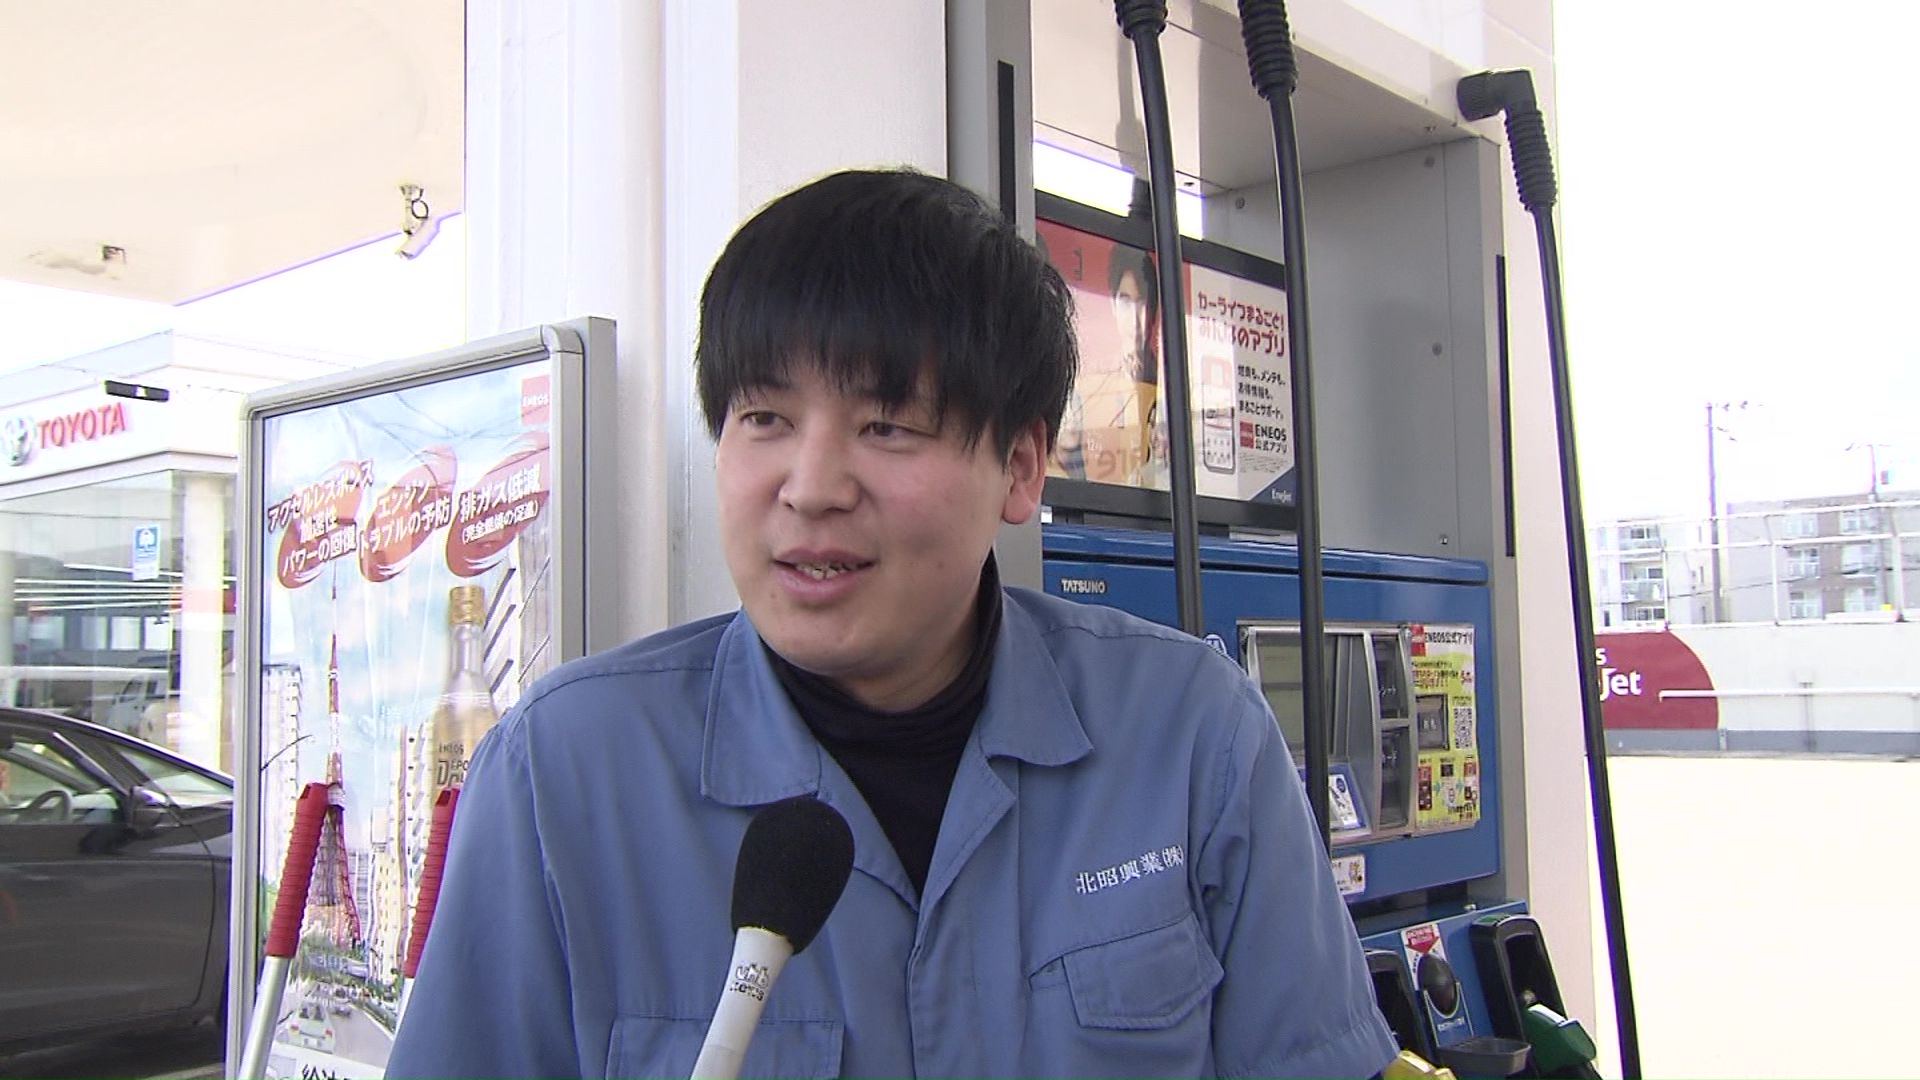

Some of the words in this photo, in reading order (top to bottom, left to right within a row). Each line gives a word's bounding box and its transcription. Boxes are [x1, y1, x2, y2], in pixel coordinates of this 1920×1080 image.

[37, 402, 127, 449] TOYOTA
[1255, 424, 1287, 441] ENEOS
[459, 463, 541, 523] 排ガス低減
[359, 495, 451, 558] トラブルの予防
[1061, 579, 1106, 594] TATSUNO
